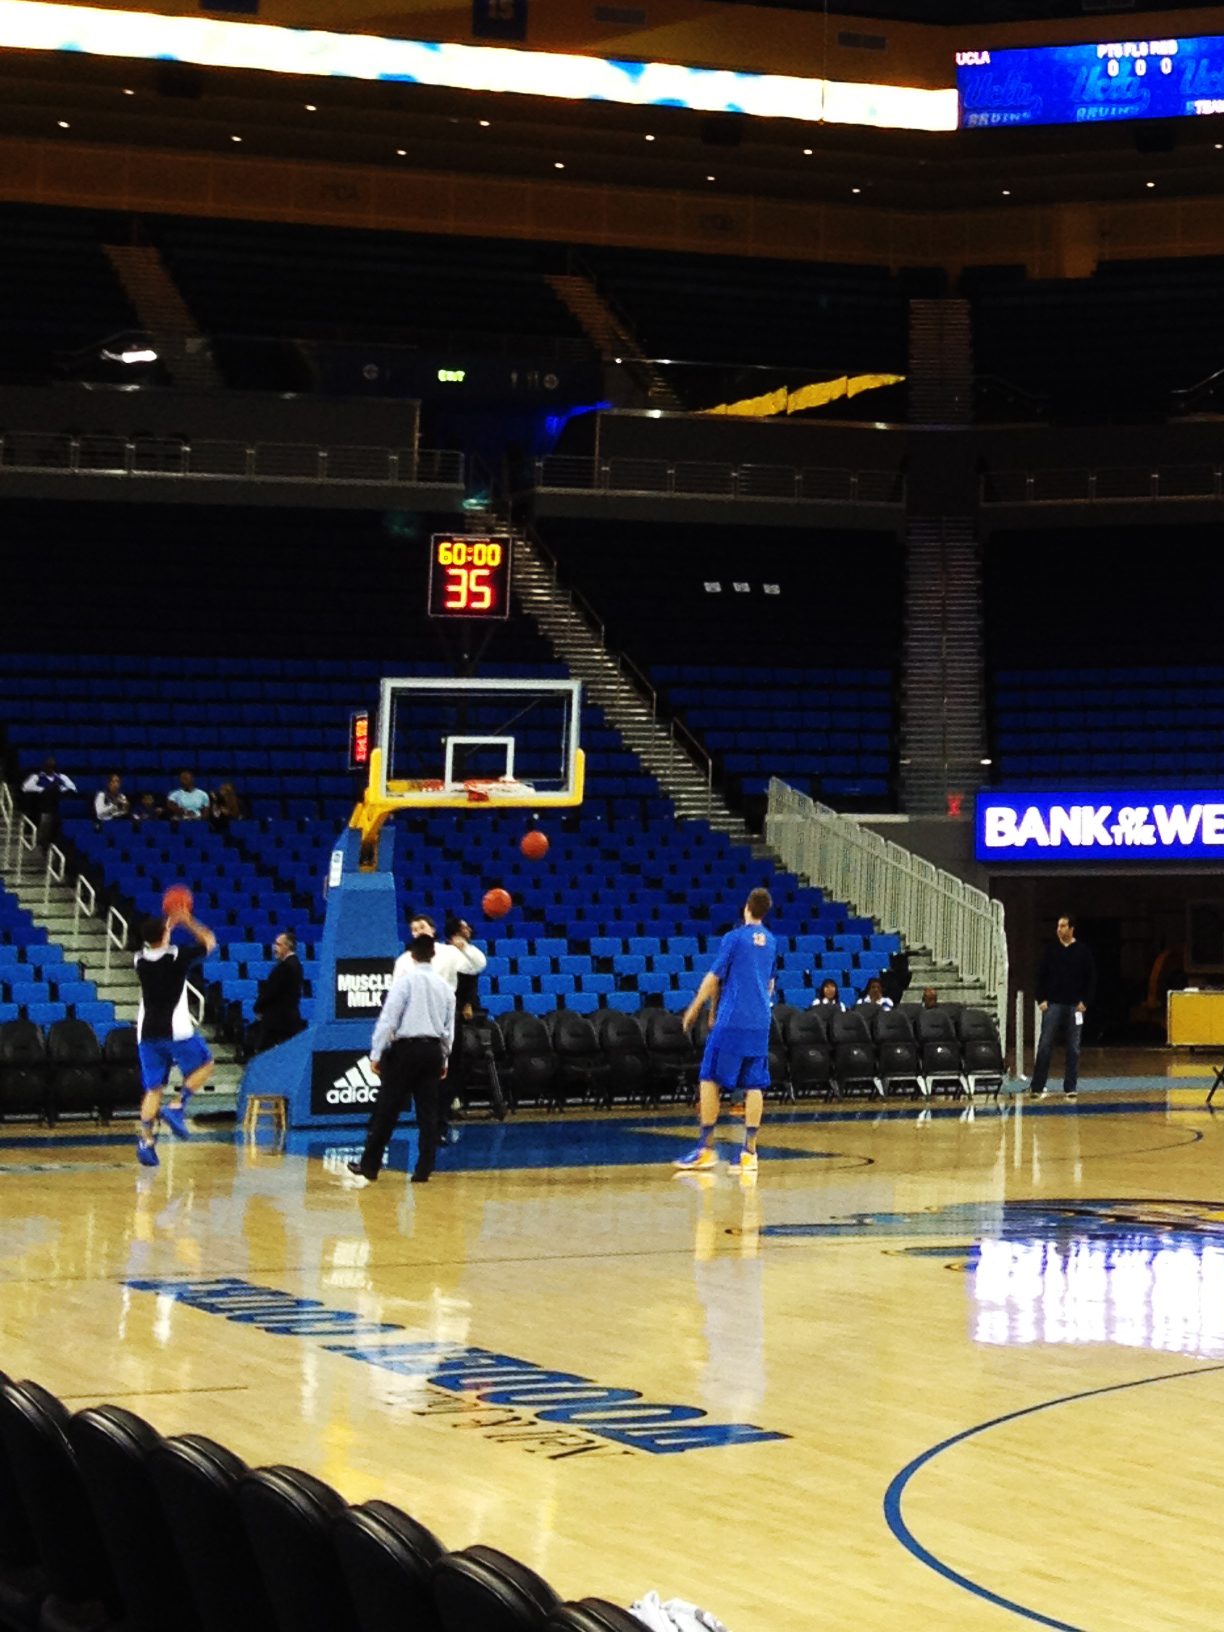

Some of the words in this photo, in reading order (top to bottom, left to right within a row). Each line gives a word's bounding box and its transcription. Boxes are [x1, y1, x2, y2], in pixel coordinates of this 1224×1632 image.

[439, 542, 501, 566] 60:00
[446, 569, 491, 609] 35
[985, 806, 1112, 847] BANK
[337, 974, 393, 992] MUSCLE
[347, 991, 382, 1008] MILK
